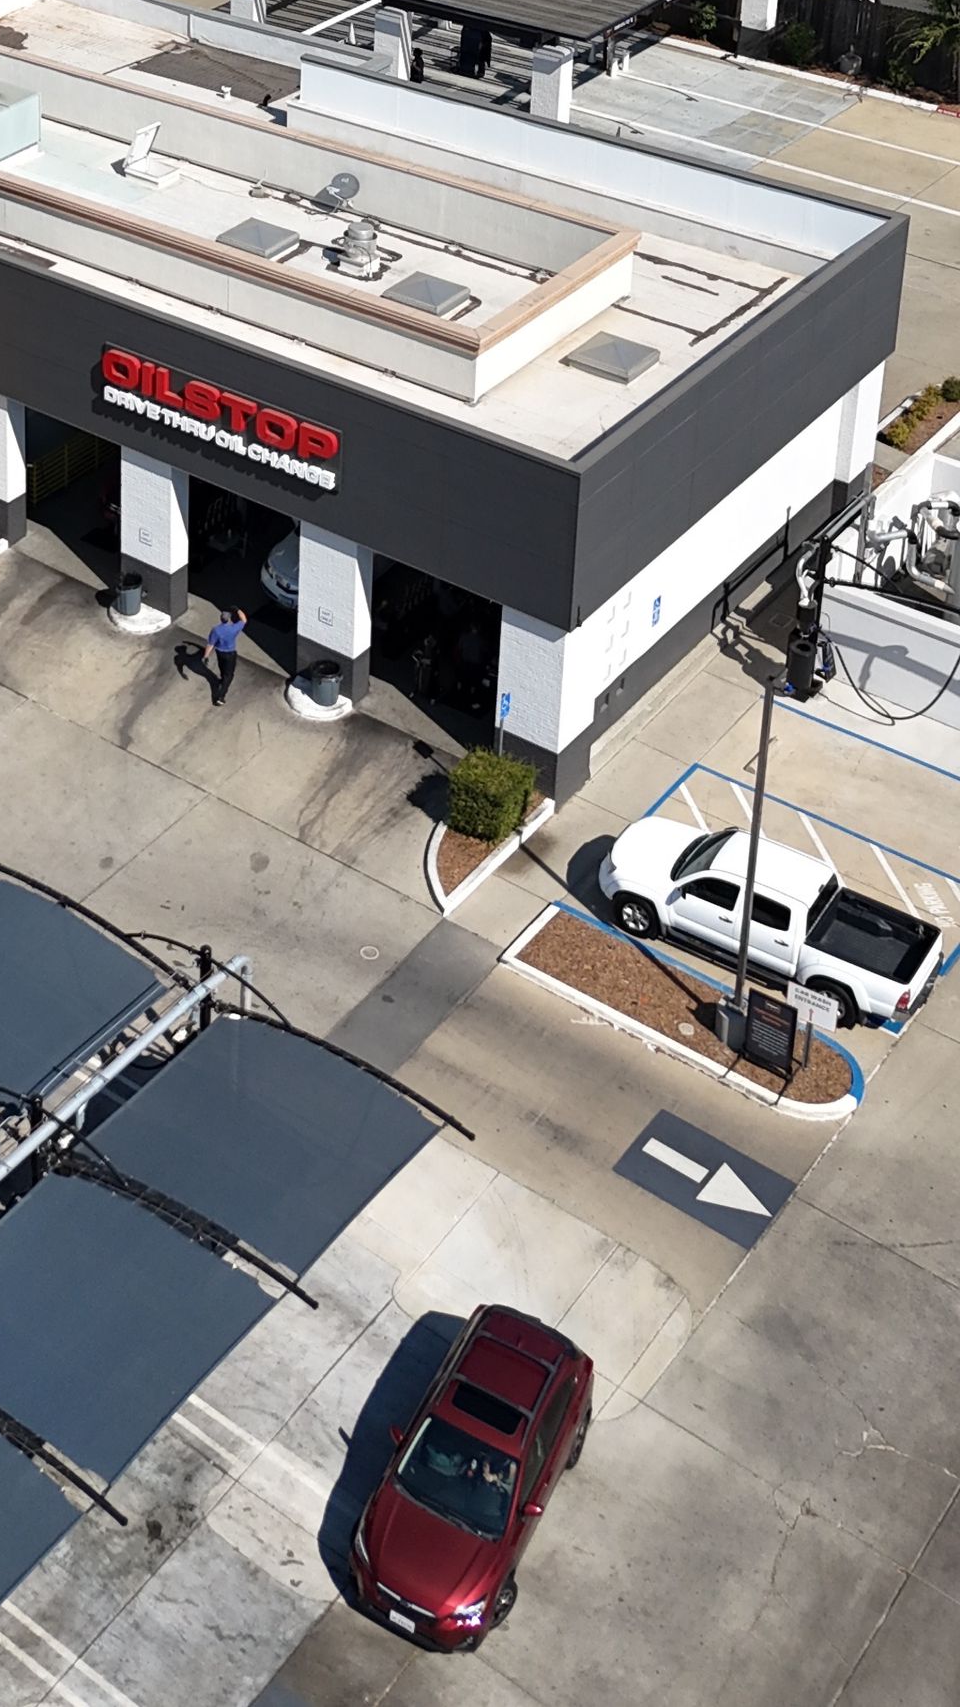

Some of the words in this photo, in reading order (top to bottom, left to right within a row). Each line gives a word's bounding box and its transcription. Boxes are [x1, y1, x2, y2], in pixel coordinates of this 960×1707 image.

[102, 349, 338, 460] OILSTOP
[103, 385, 161, 421] DRIVE
[160, 408, 216, 442] THRU
[215, 429, 248, 456] OIL
[247, 443, 336, 491] CHANGE
